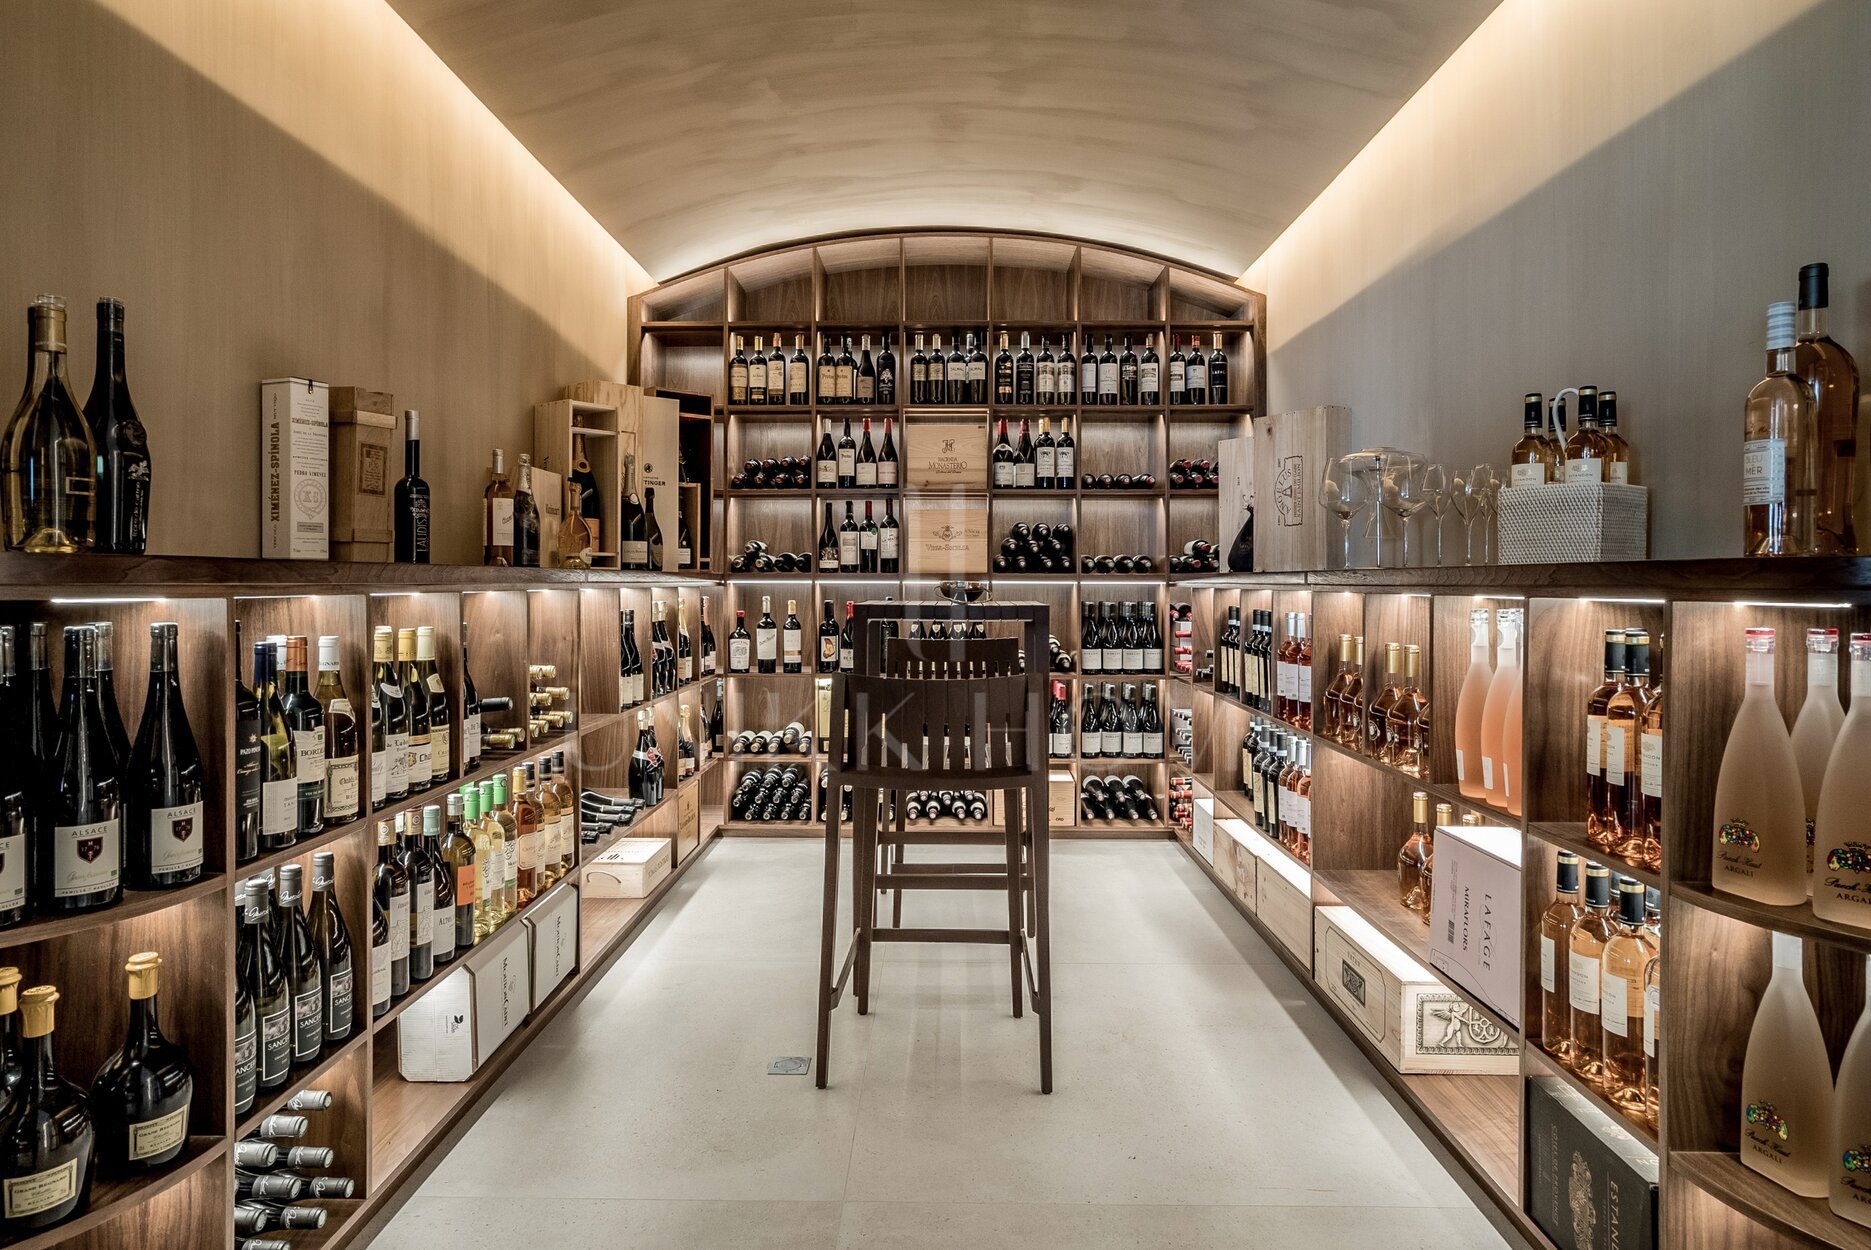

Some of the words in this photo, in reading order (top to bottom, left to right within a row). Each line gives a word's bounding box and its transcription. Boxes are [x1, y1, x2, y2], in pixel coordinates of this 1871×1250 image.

[270, 422, 280, 522] XIMÉNEZ-SPÍNOLA
[928, 461, 968, 470] MONASTERIO
[1745, 466, 1763, 476] MER
[1277, 469, 1292, 514] ANGELUS
[167, 807, 196, 817] ALSACE
[71, 826, 108, 837] ALSACE
[1724, 865, 1754, 878] ARGALI
[1824, 877, 1871, 893] Puech-H
[1463, 886, 1471, 952] MIRAFLORS
[1484, 894, 1492, 972] LAFAGE
